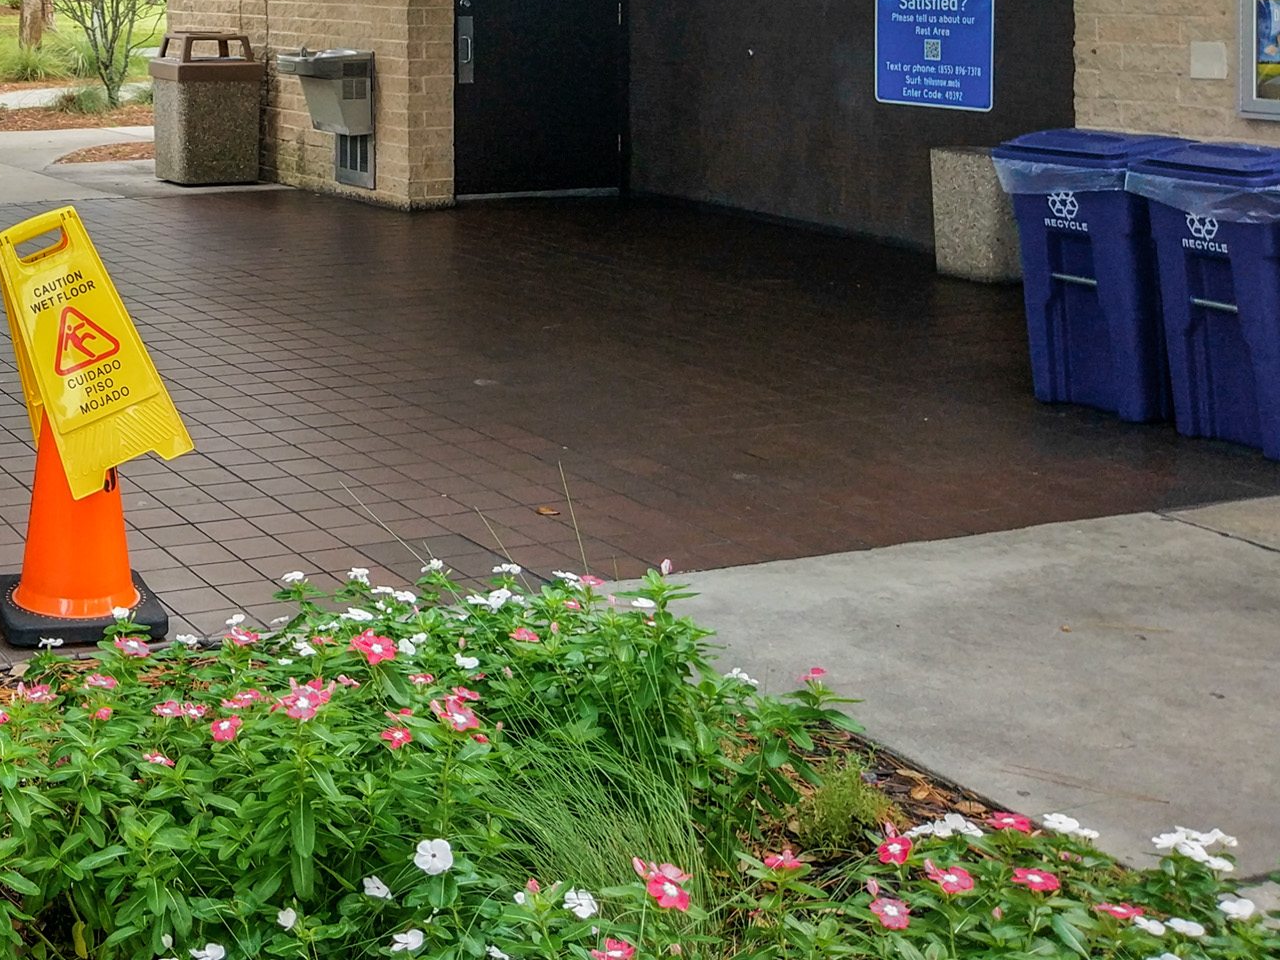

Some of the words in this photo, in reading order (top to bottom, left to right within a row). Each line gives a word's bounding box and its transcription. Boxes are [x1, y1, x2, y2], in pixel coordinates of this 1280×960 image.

[891, 12, 914, 22] Please
[916, 14, 927, 23] tell
[928, 15, 937, 23] us
[938, 14, 960, 24] about
[962, 16, 975, 25] our
[915, 26, 931, 36] Rest
[932, 27, 950, 36] Area
[886, 61, 902, 71] Text
[902, 87, 921, 97] Enter
[1044, 218, 1088, 232] RECYCLE
[1182, 238, 1228, 253] RECYCLE
[33, 270, 83, 298] CAUTION
[30, 296, 55, 314] WET
[56, 280, 96, 304] FLOOR
[67, 359, 121, 389] CUIDADO
[85, 377, 114, 397] PISO
[80, 386, 130, 415] MOJADO
